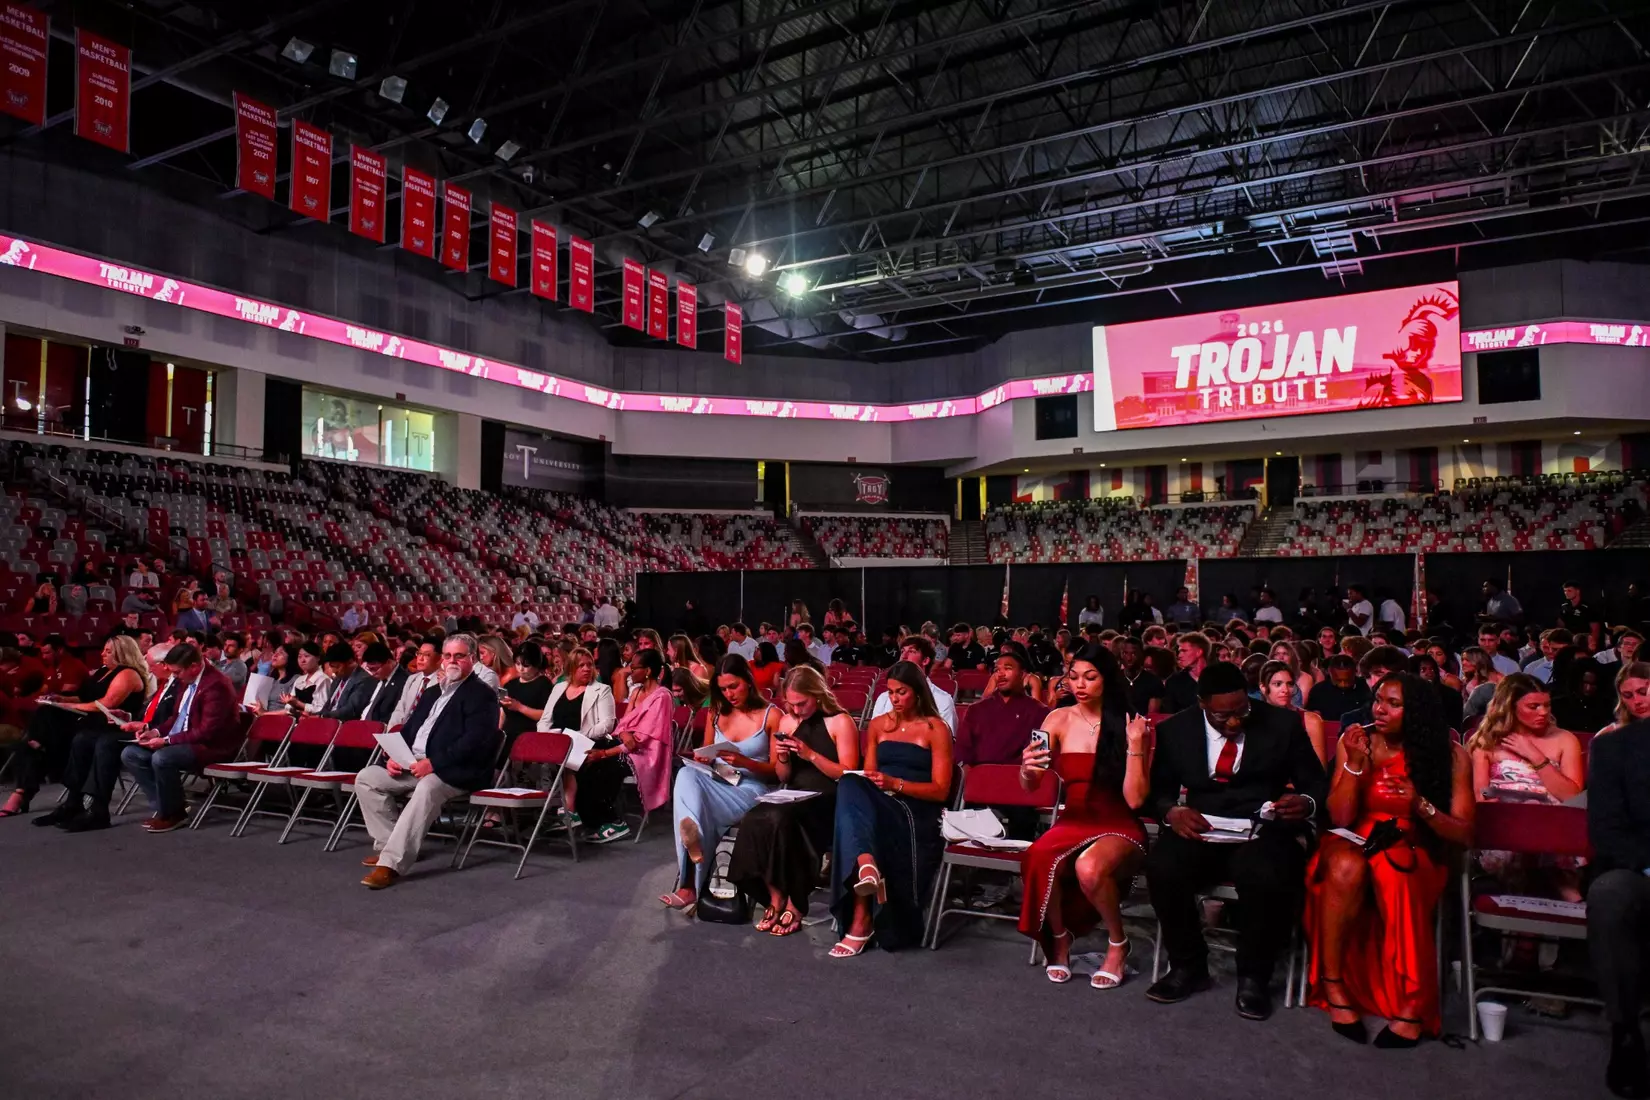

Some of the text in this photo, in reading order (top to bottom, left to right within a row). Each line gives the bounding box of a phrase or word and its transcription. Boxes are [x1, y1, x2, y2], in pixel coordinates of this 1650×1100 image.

[6, 5, 34, 23] MEN'S
[0, 12, 46, 40] ASKETBALL
[91, 41, 117, 58] MEN'S
[80, 47, 129, 72] BASKETBALL
[94, 95, 113, 108] 2010
[241, 101, 272, 119] WOMEN'S
[239, 108, 276, 129] BASKETBALL
[296, 135, 330, 155] BASKETBALL
[299, 128, 327, 145] WOMEN'S
[253, 148, 269, 160] 2021
[353, 159, 385, 178] BASKETBALL
[404, 181, 435, 198] BASKETBALL
[100, 263, 154, 289] TROJAN
[107, 279, 145, 295] TRIBUTE
[235, 297, 279, 321] TROJAN
[1237, 319, 1284, 337] 2026
[1468, 328, 1516, 344] TROJAN
[1590, 324, 1626, 338] TROJAN
[1171, 325, 1358, 390] TROJAN
[1199, 377, 1328, 409] TRIBUTE
[504, 451, 520, 461] ROY
[533, 457, 581, 471] UNIVERSITY
[861, 484, 883, 495] TROY
